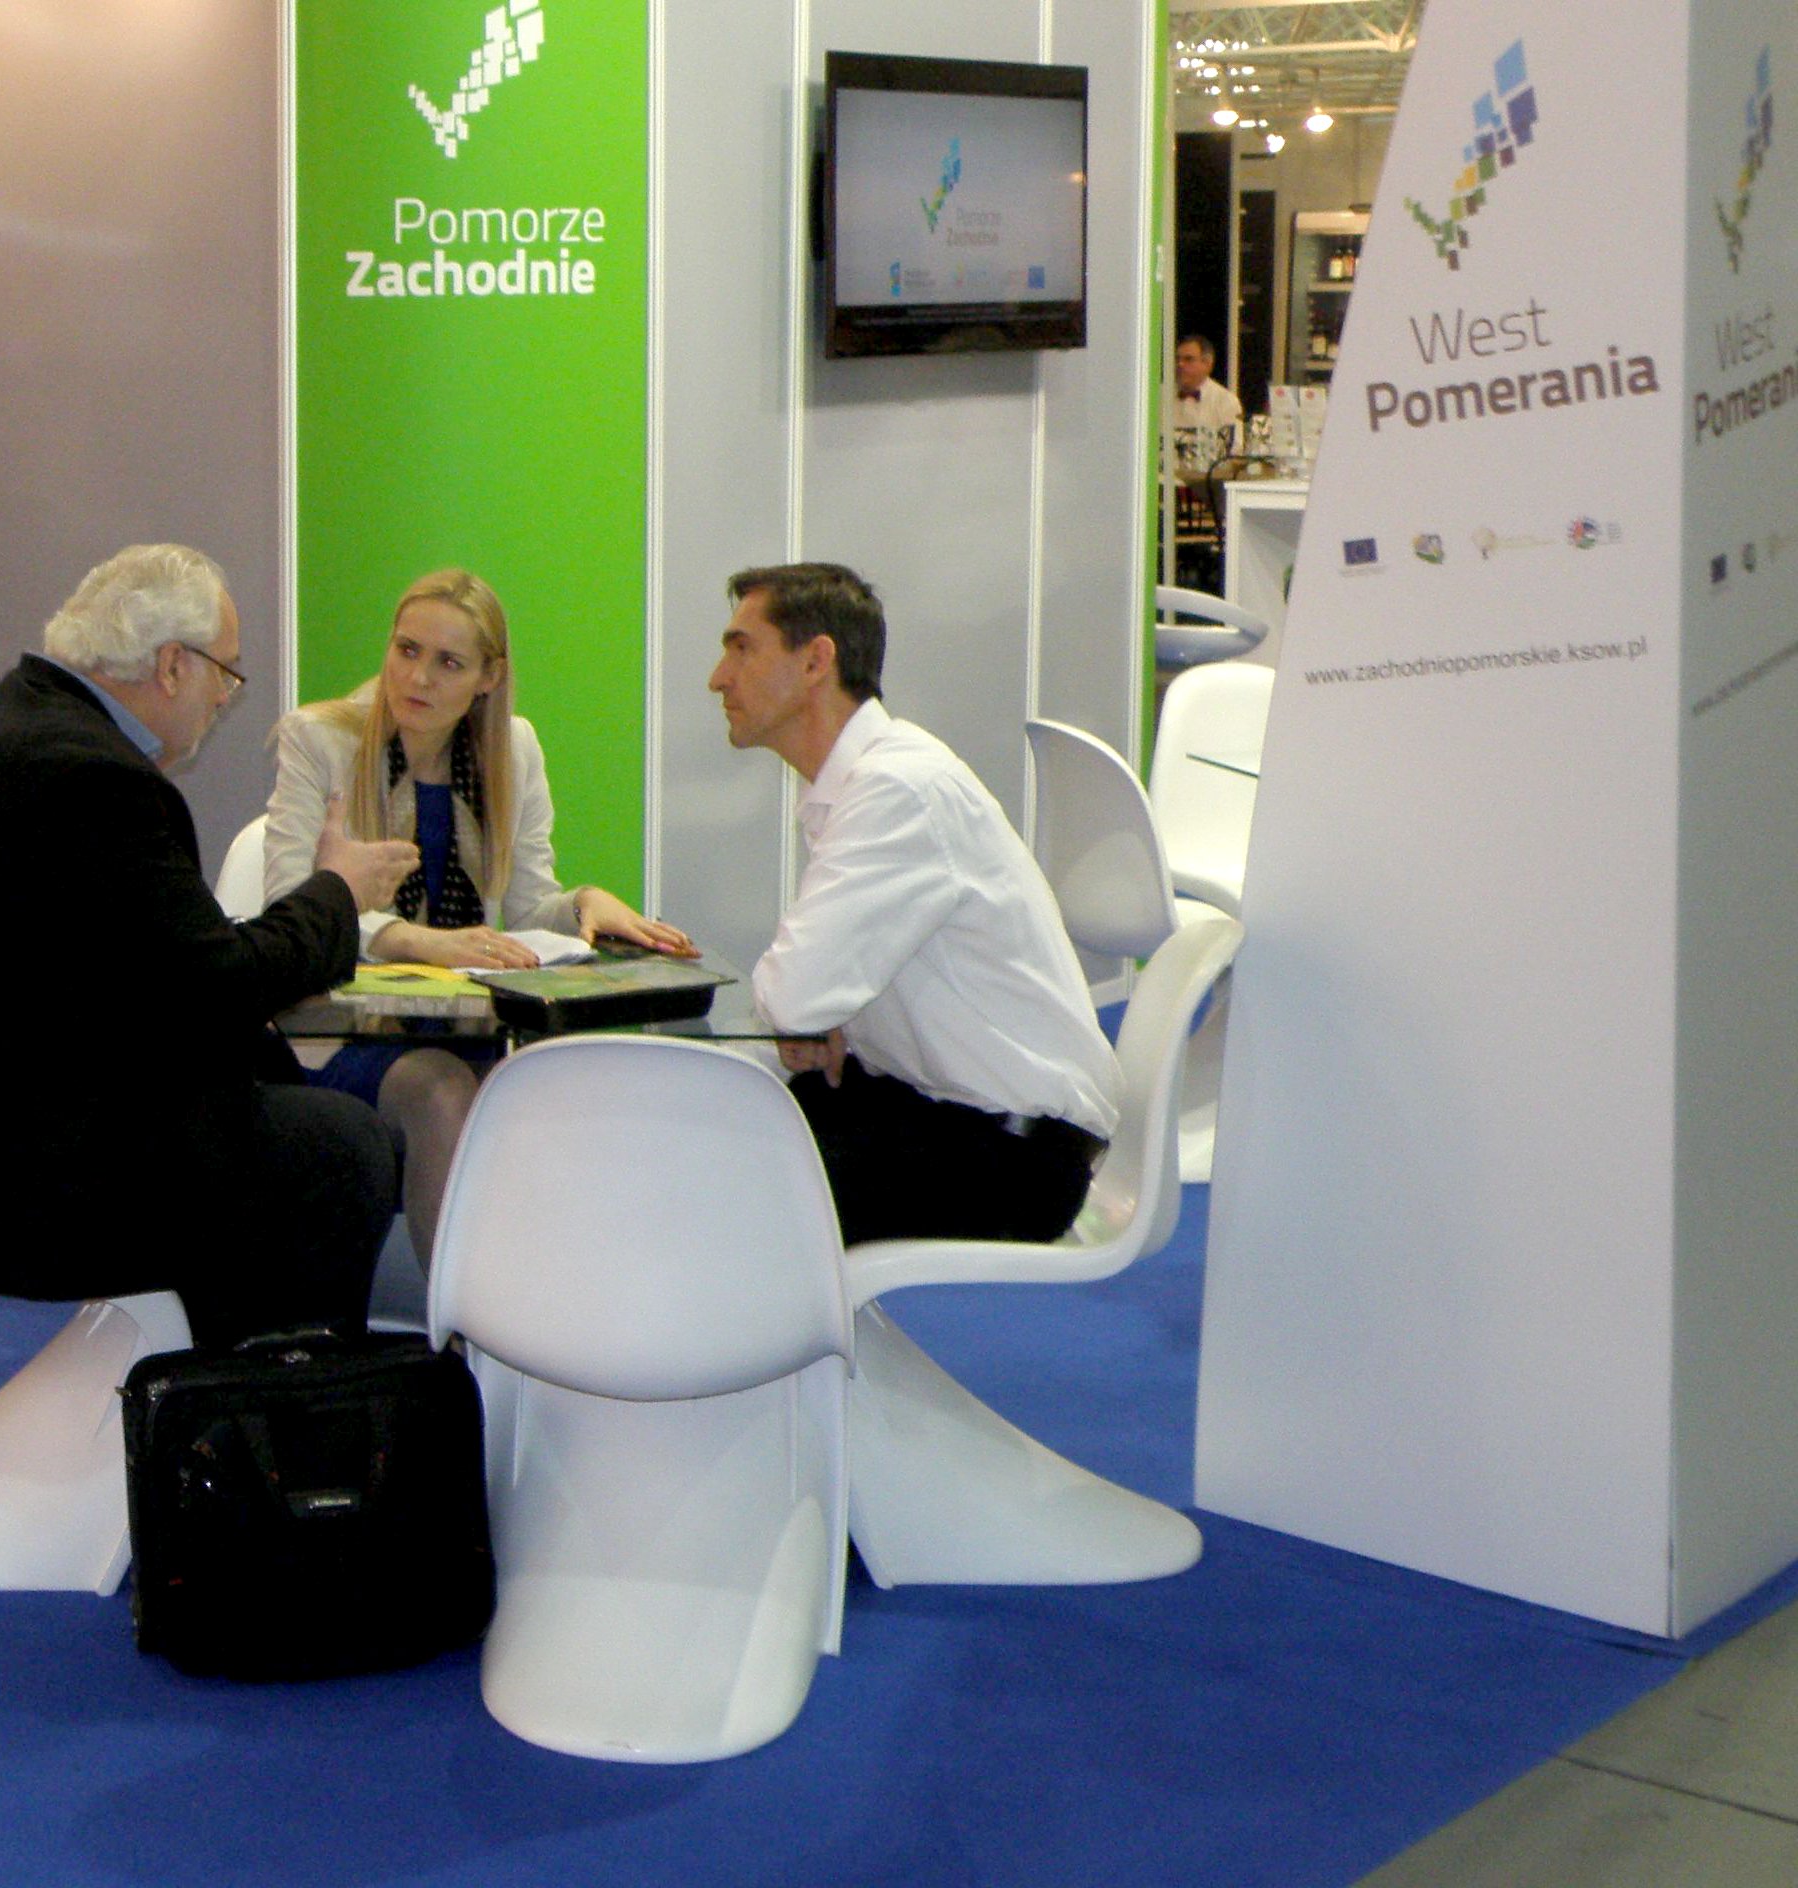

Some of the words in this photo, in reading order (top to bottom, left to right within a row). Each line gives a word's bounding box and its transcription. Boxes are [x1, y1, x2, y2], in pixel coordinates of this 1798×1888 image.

[393, 197, 606, 245] Pomorze
[345, 248, 597, 297] Zachodnie
[1409, 297, 1553, 366] West
[1714, 303, 1775, 372] West
[1365, 344, 1661, 433] Pomerania
